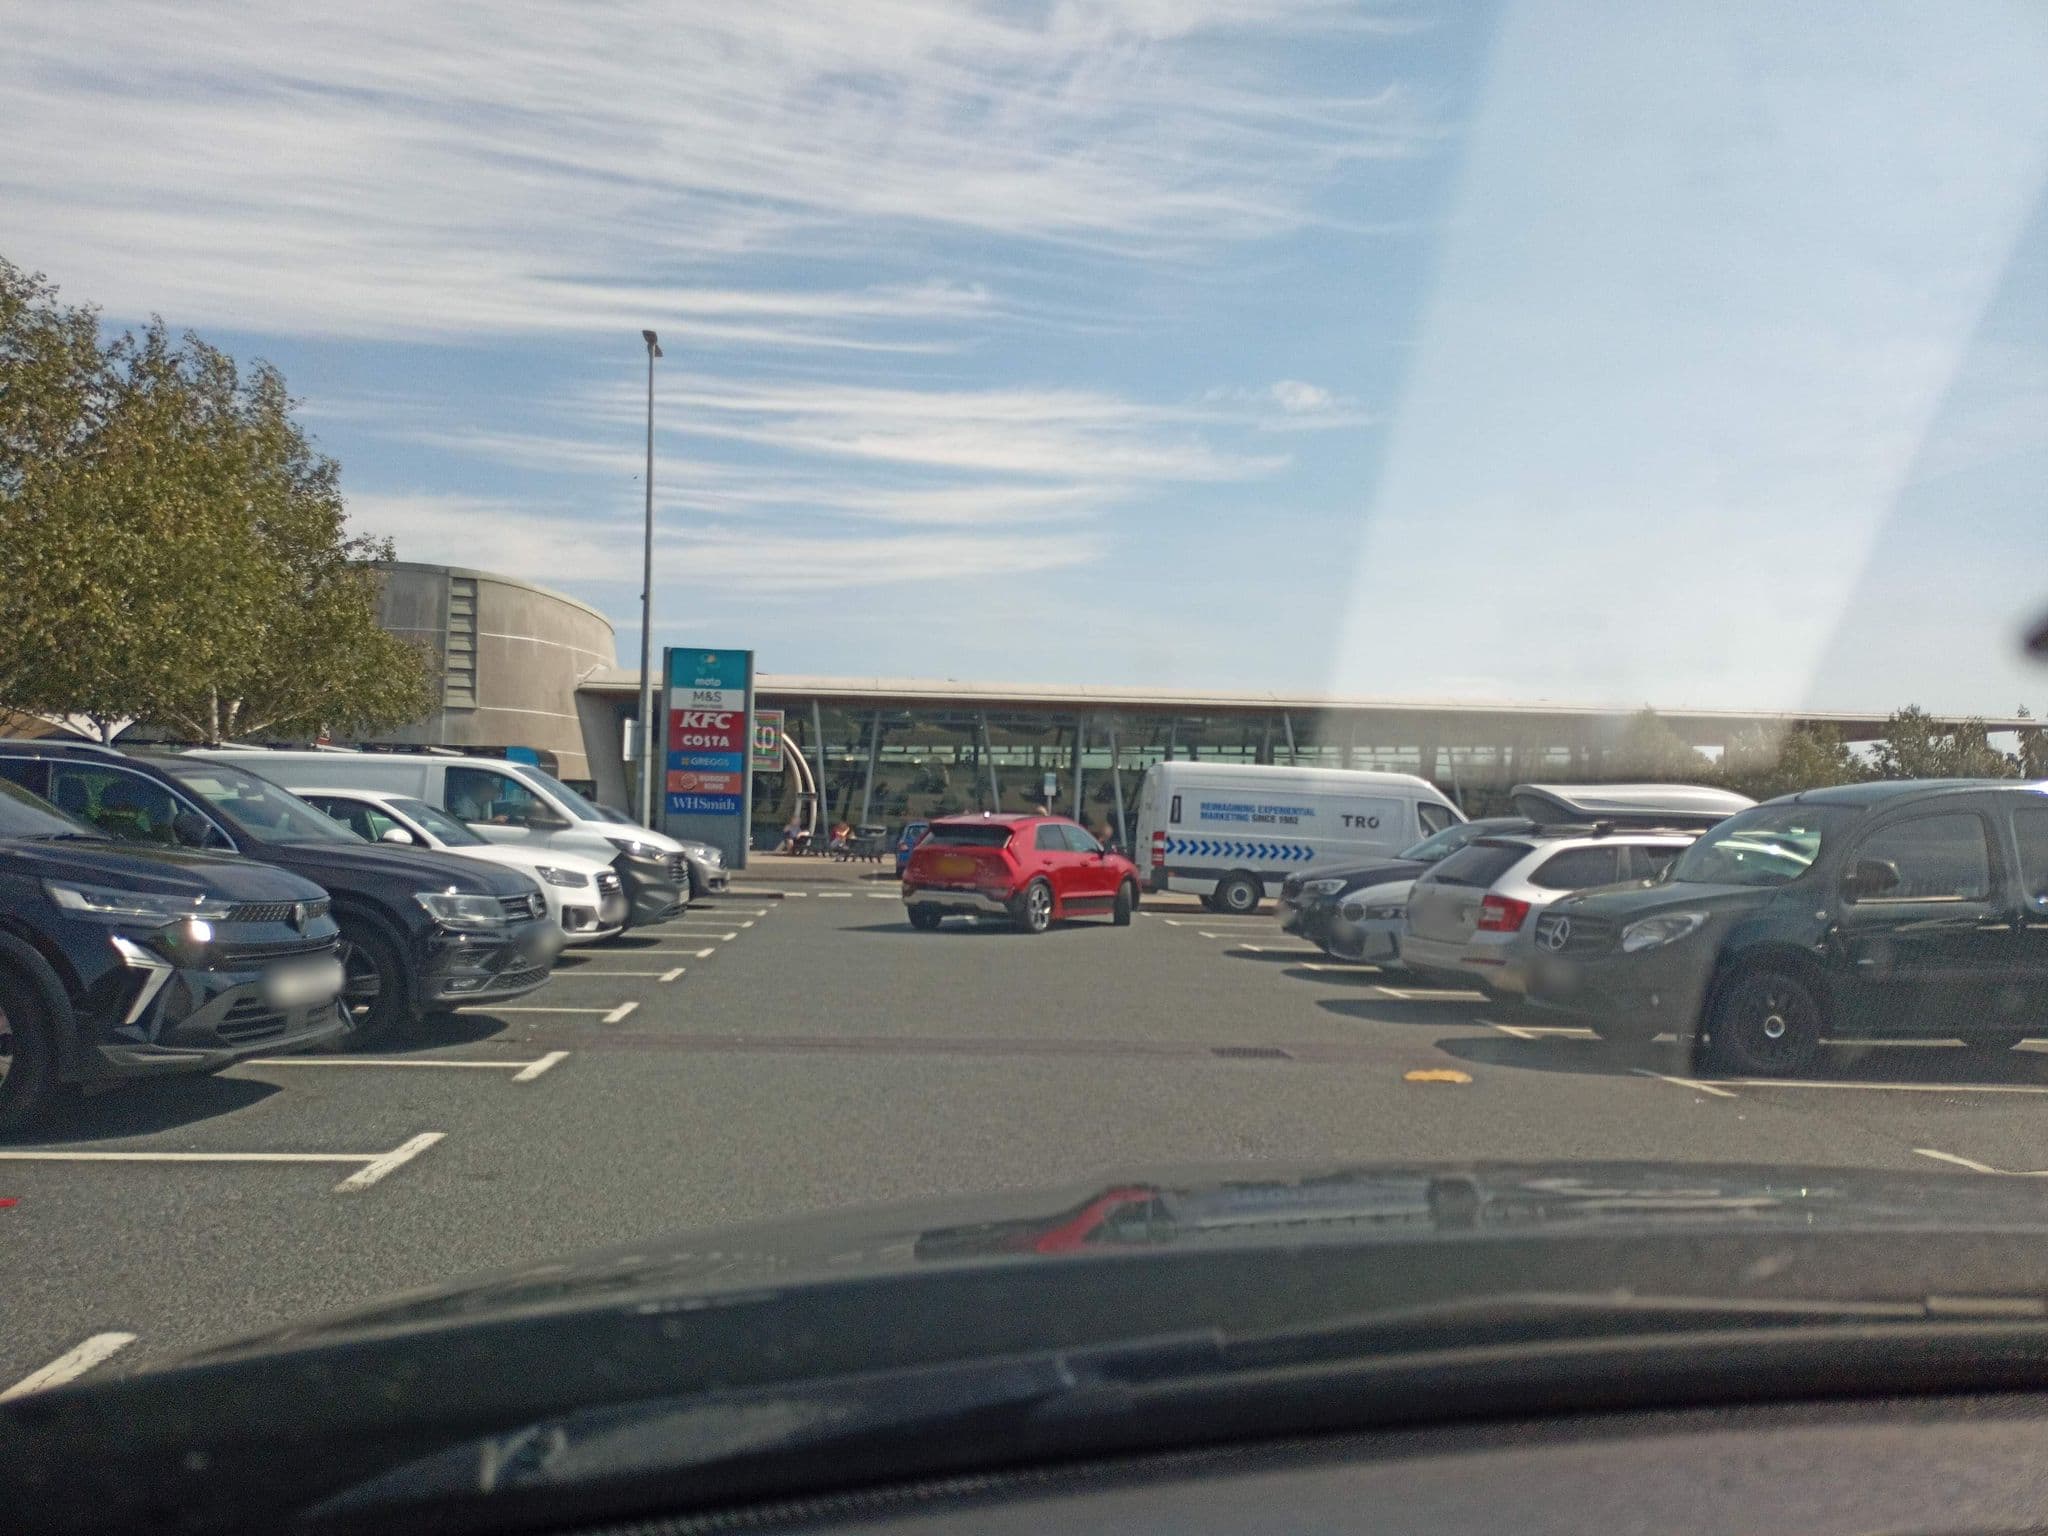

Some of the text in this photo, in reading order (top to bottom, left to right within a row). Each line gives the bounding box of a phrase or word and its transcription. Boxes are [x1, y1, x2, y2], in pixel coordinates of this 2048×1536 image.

[692, 690, 722, 702] M&S
[680, 711, 733, 729] KFC
[683, 735, 730, 747] COSTA
[690, 757, 730, 767] GREGGS
[673, 797, 735, 810] WHSmith
[1258, 805, 1316, 816] EXPERIENTIAL
[1201, 812, 1250, 822] MARKETING
[1251, 814, 1276, 824] SINCE
[1341, 814, 1380, 829] TRO
